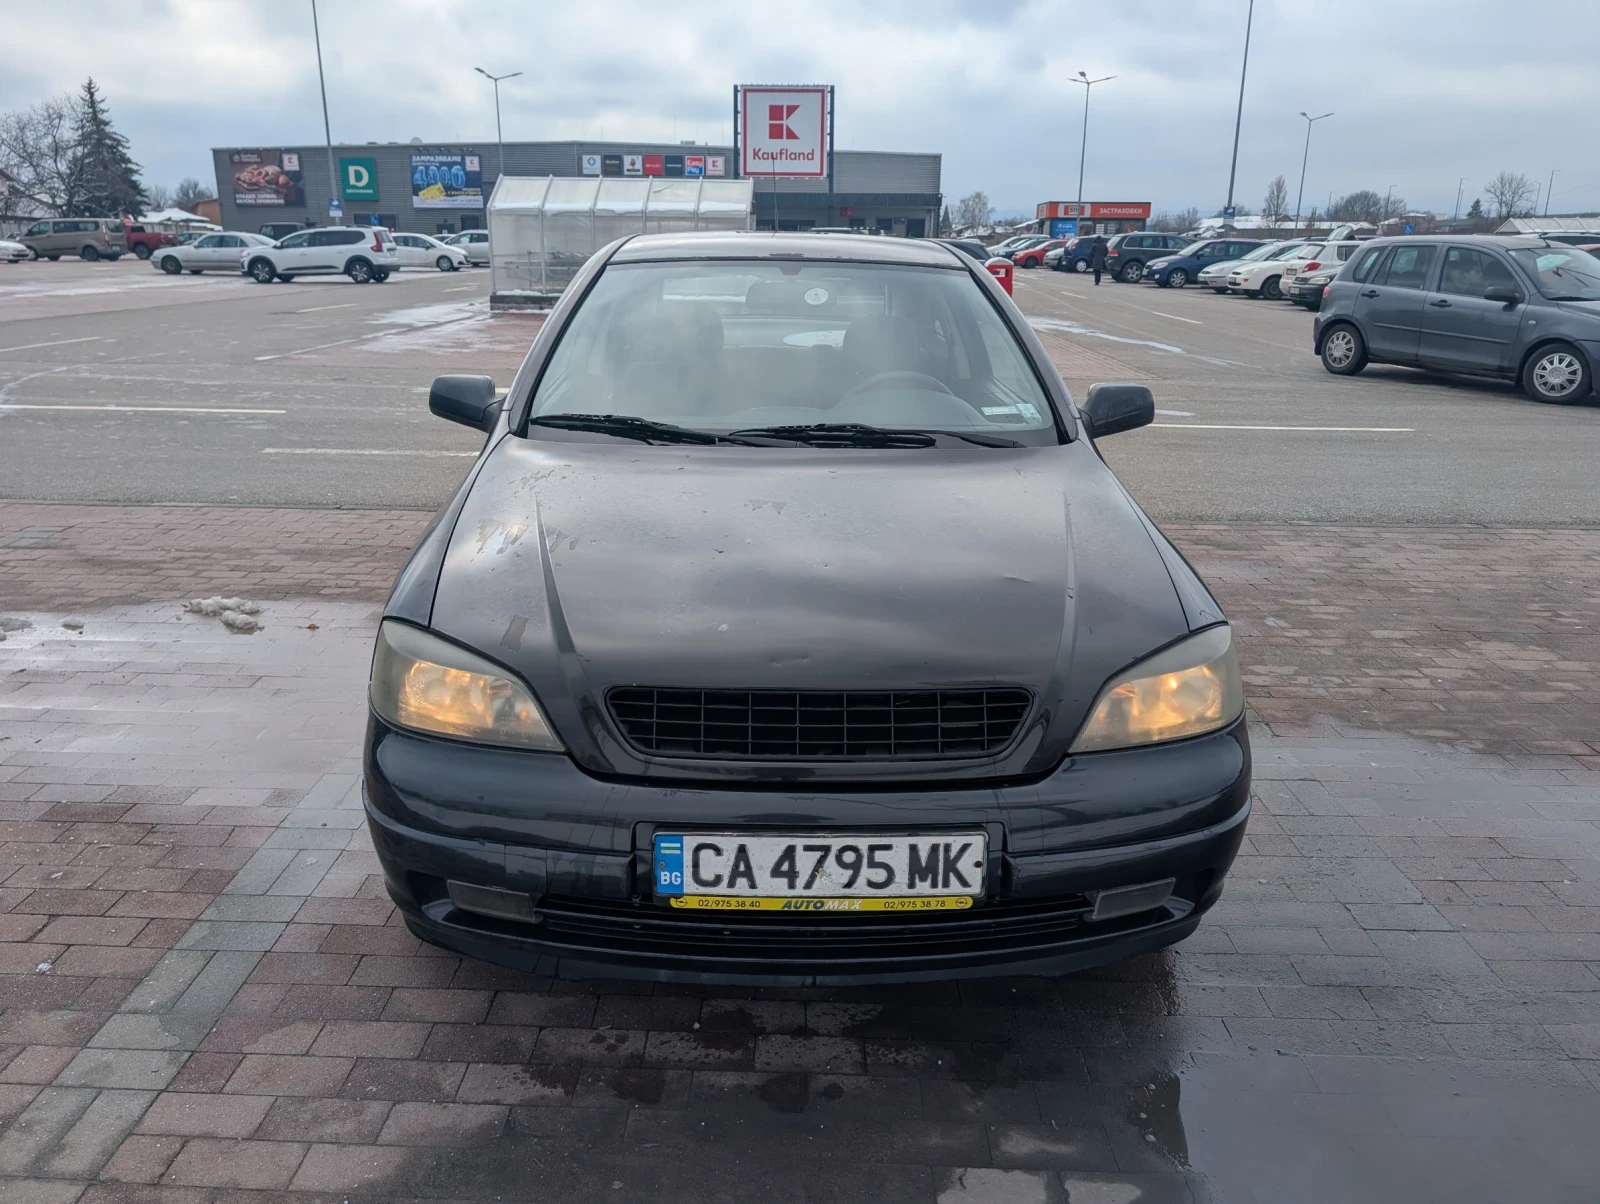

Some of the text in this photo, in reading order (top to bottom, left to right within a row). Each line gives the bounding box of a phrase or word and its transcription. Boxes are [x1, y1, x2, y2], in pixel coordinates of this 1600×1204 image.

[753, 148, 814, 160] Kaufland
[348, 165, 369, 187] D
[692, 843, 973, 890] CA 4795 MK
[660, 871, 681, 885] BG
[698, 899, 761, 908] 02/975 38 40
[781, 900, 863, 910] AUTOMAX
[884, 900, 946, 909] 02/975 38 78
